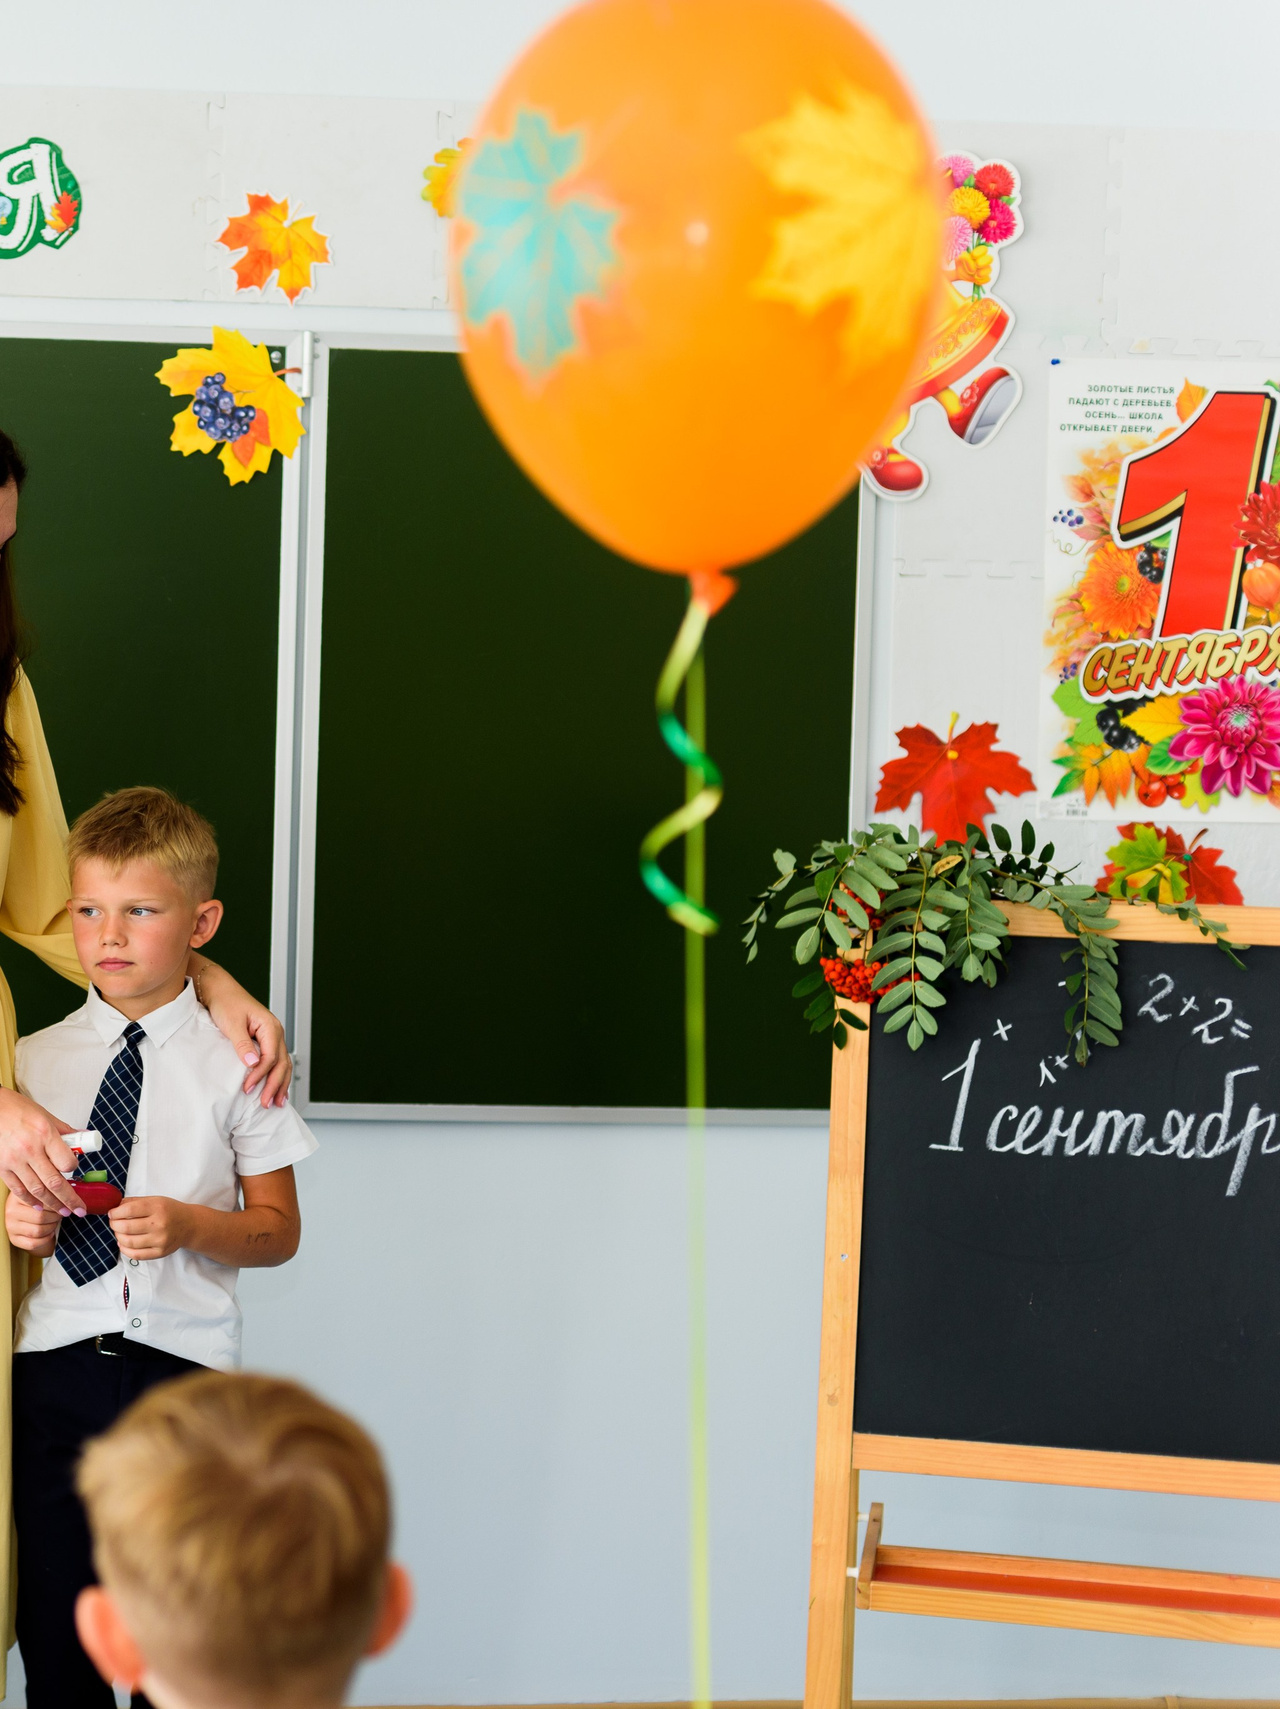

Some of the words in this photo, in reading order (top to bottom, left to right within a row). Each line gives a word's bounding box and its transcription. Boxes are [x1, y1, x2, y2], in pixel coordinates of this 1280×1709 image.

[1087, 384, 1134, 393] ЗОЛОТЫЕ
[1136, 386, 1175, 394] ЛИСТЬЯ
[1068, 397, 1110, 406] ПАДАЮТ
[1122, 398, 1175, 408] ДЕРЕВЬЕВ.
[1129, 412, 1164, 420] ШКОЛА
[1060, 424, 1118, 432] ОТКРЫВАЕТ
[1120, 425, 1156, 433] ДВЕРИ.
[1117, 390, 1277, 640] 1
[928, 1038, 982, 1152] 1
